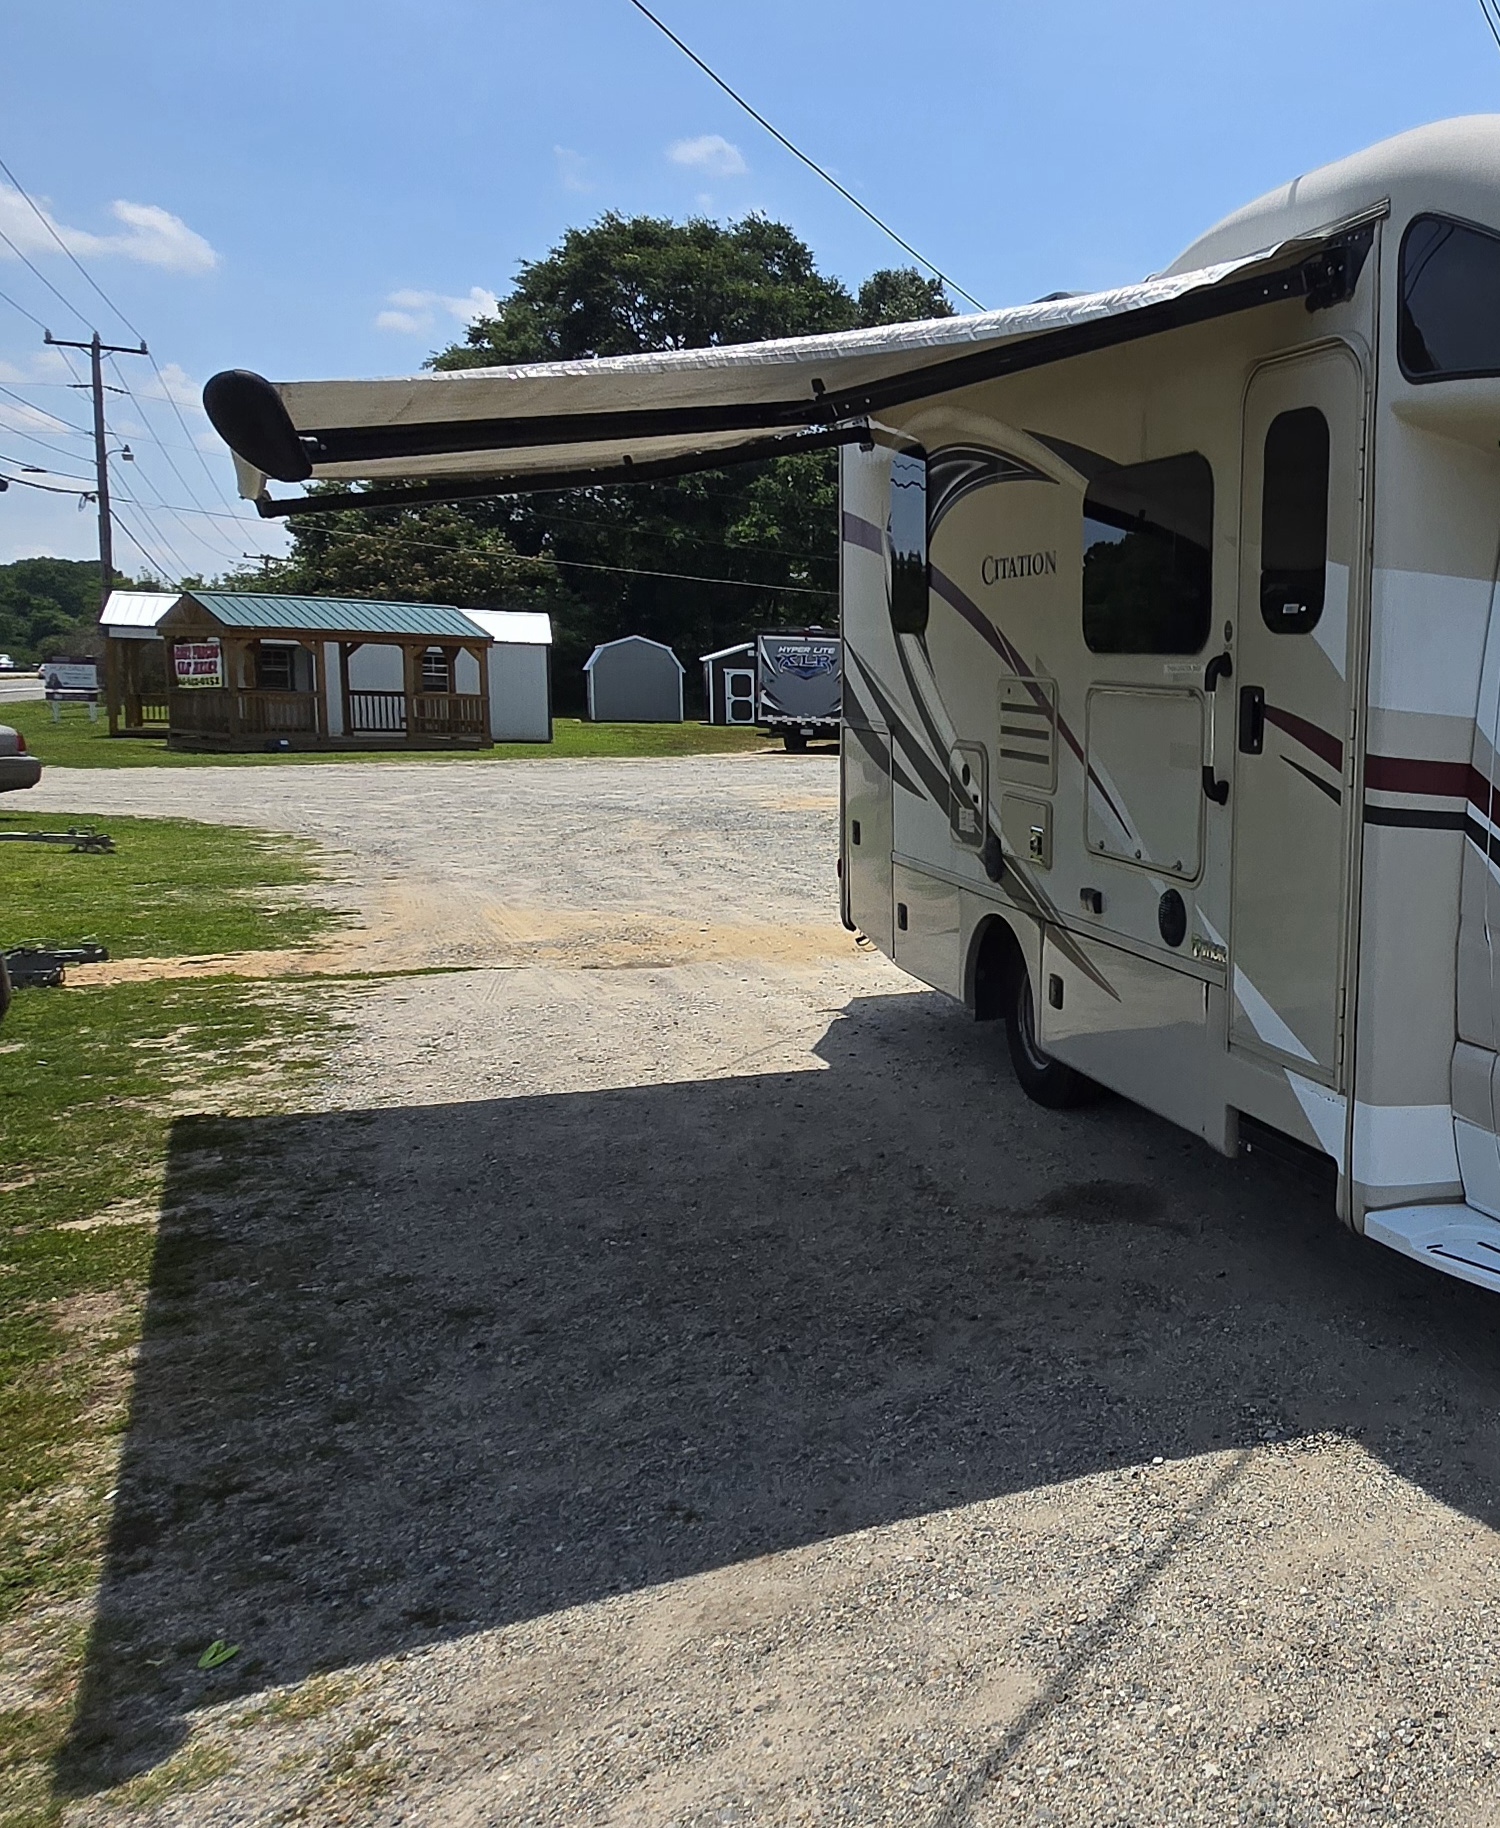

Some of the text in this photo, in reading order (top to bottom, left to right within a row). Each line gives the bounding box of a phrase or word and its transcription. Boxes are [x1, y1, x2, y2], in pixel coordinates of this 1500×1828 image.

[981, 550, 1057, 586] CITATION
[778, 646, 811, 654] HYPER
[777, 653, 833, 675] XLR
